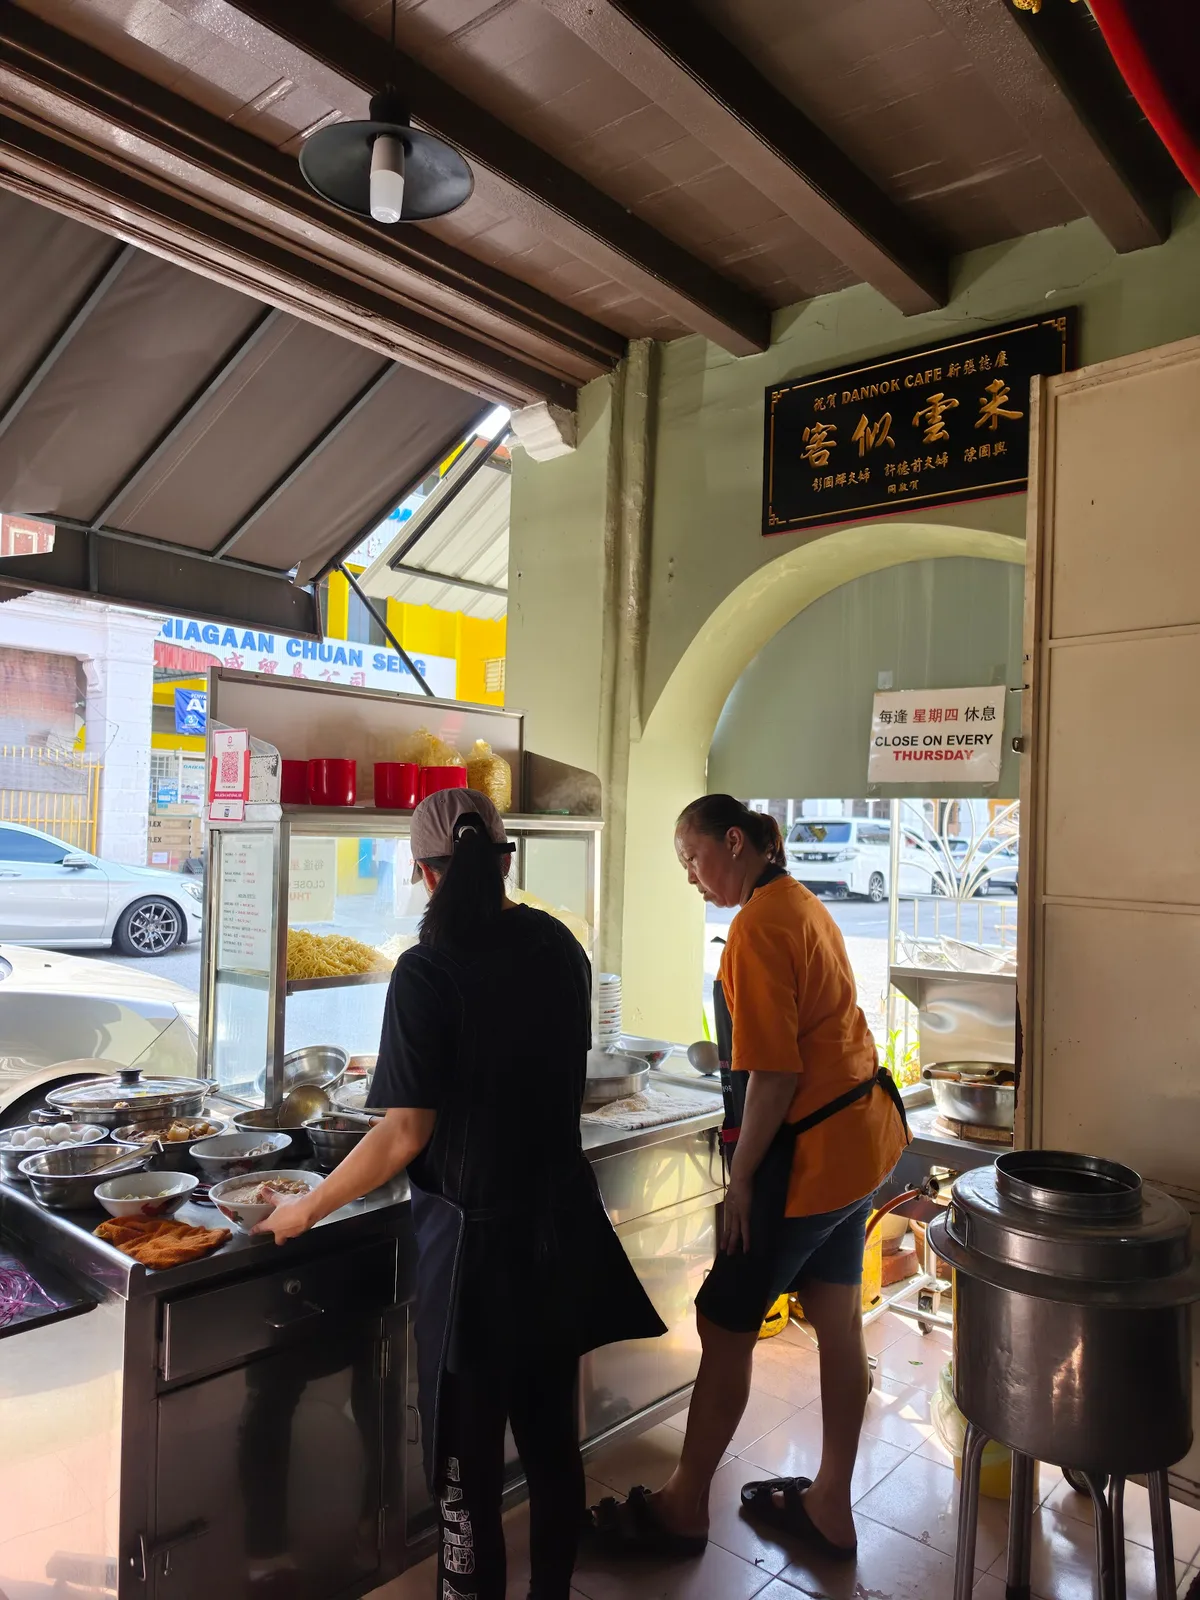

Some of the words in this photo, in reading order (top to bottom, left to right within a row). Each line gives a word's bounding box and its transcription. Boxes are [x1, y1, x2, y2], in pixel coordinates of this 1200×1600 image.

[841, 378, 901, 405] DANNOK
[904, 367, 942, 388] CAFE
[285, 638, 363, 668] CHUAN
[372, 653, 427, 677] SENG
[878, 709, 908, 725] 每逢
[912, 708, 959, 723] 星期四
[964, 706, 997, 722] 休息
[874, 735, 919, 747] CLOSE
[922, 735, 942, 746] ON
[946, 734, 994, 745] EVERY
[892, 749, 975, 761] THURSDAY
